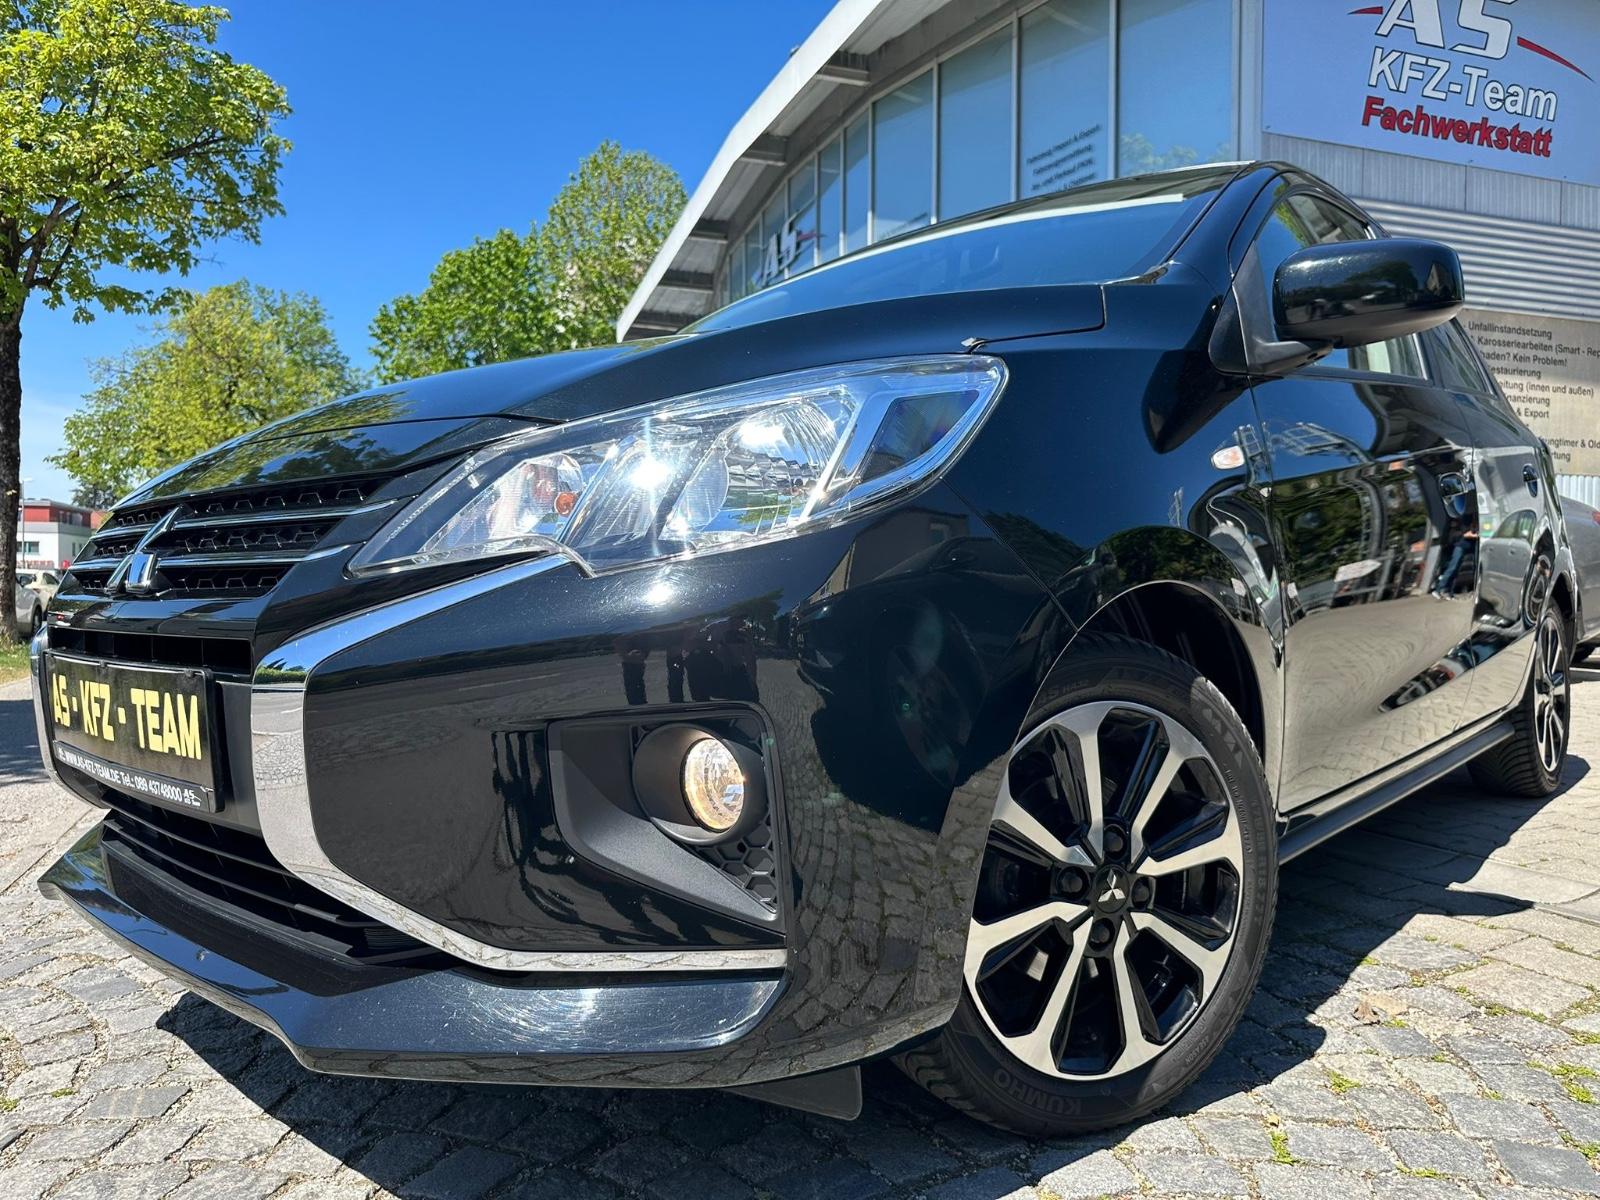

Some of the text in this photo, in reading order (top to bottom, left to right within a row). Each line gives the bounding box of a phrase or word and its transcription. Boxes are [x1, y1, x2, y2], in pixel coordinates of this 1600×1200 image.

[1374, 0, 1518, 60] AS
[1368, 46, 1558, 121] KFZ-Team
[1361, 95, 1553, 158] Fachwerkstatt
[1468, 321, 1552, 340] Unfallinstandsetzung
[1477, 335, 1552, 352] Karosseriearbeiten
[1555, 344, 1581, 356] (Smart
[1512, 353, 1531, 363] Kein
[1532, 355, 1568, 367] Problem!
[1488, 365, 1541, 379] estaurierung
[1526, 381, 1550, 394] (innen
[1551, 384, 1567, 394] und
[1568, 386, 1594, 398] außen)
[1505, 394, 1550, 407] nanzierung
[1524, 409, 1550, 418] Export
[52, 672, 71, 728] AS
[79, 680, 115, 742] KFZ
[130, 687, 202, 760] TEAM
